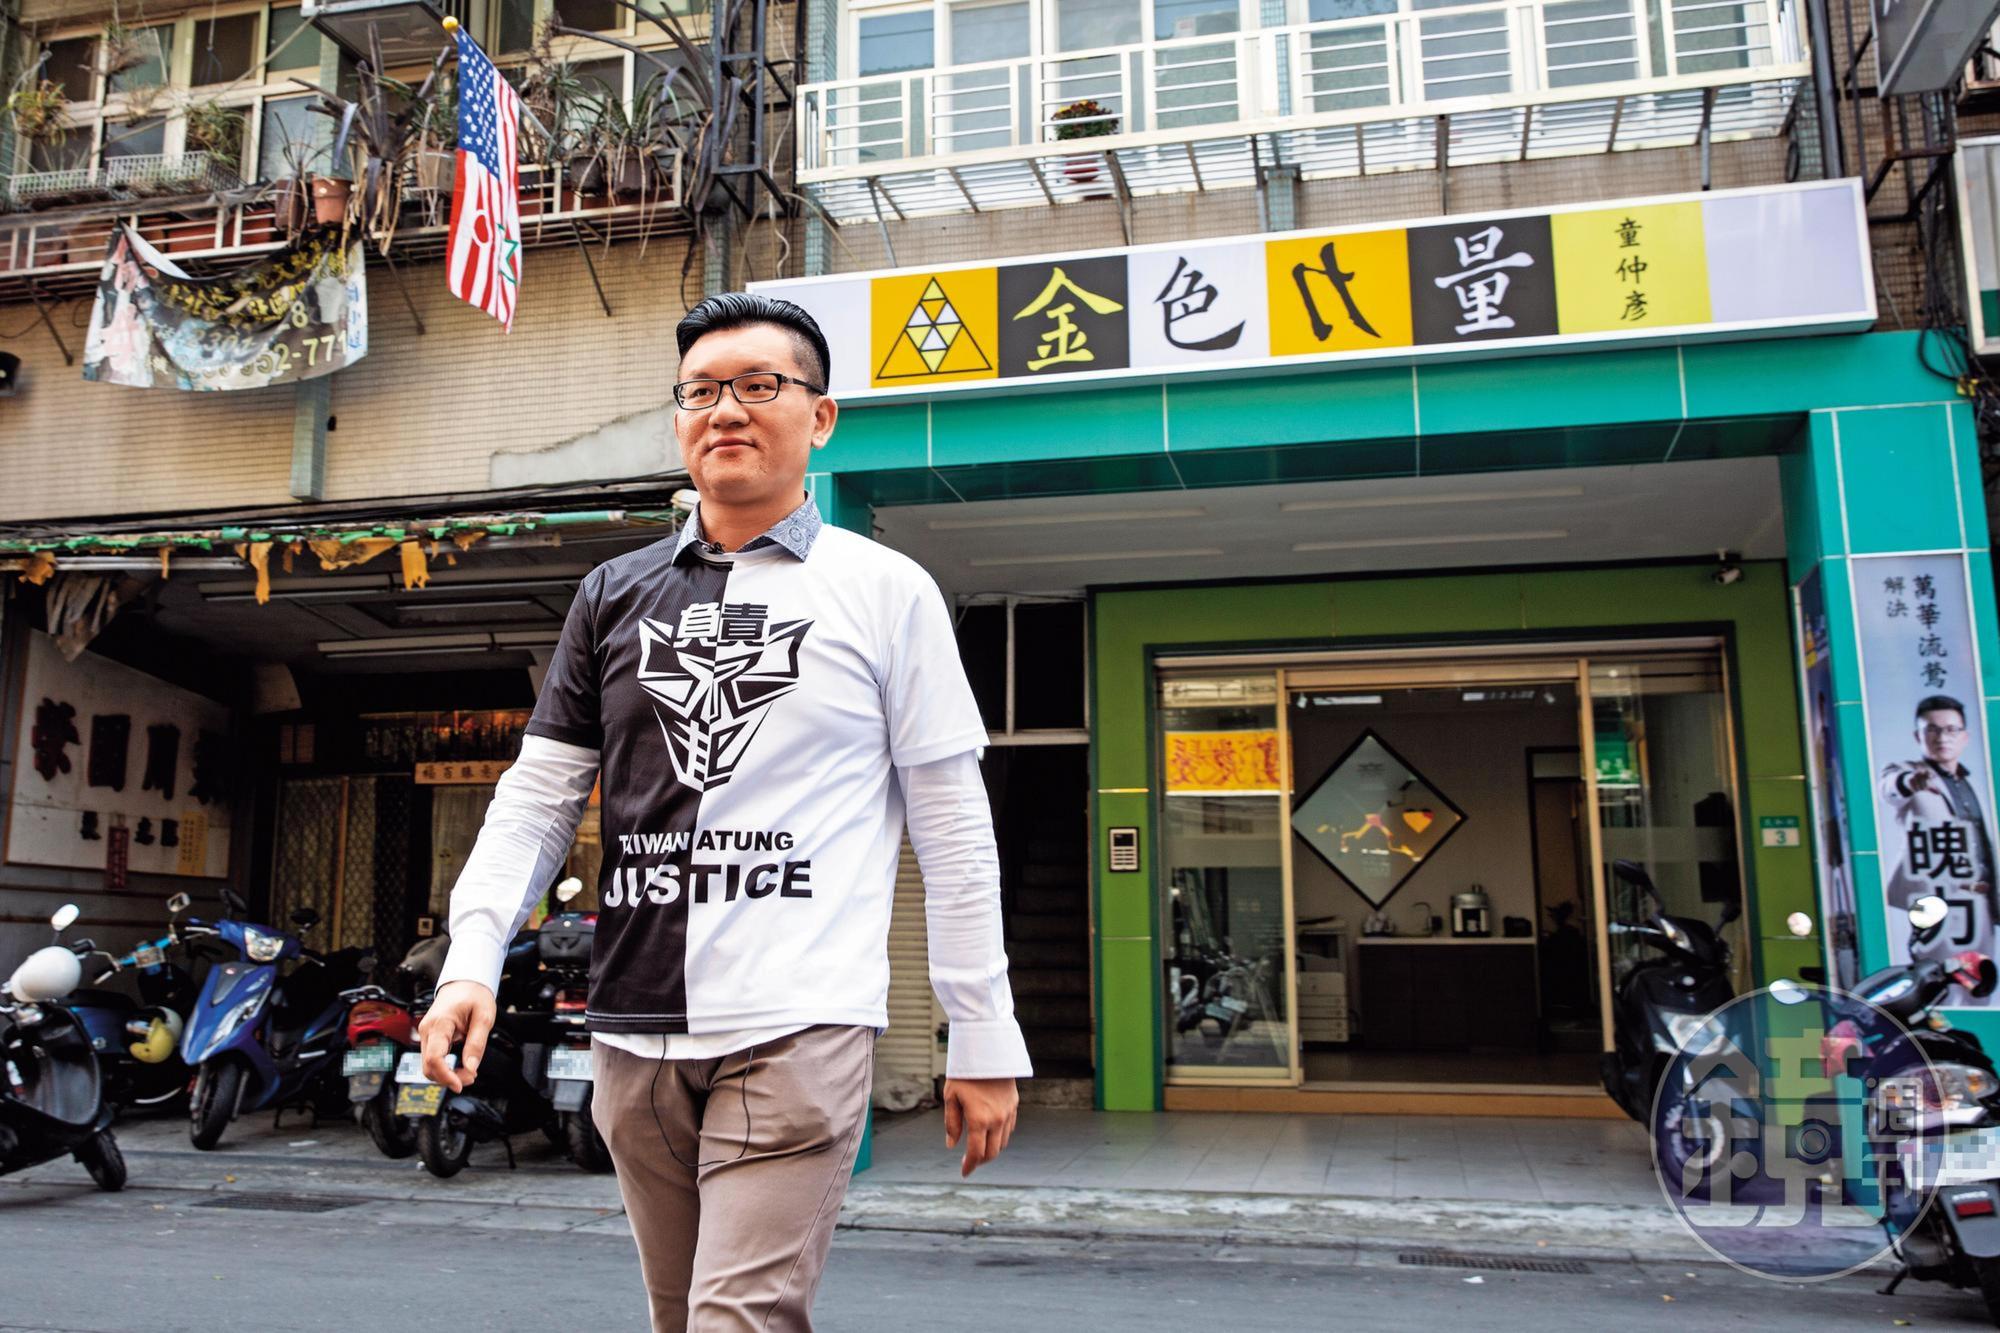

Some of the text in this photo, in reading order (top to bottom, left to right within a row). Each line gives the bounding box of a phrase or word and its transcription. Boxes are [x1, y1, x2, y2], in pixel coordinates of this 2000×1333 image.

[1883, 575, 1908, 618] 解決
[673, 602, 768, 649] 負責
[1912, 573, 1948, 689] 萬華流鶯
[619, 830, 794, 855] TAIWAN ATUNG
[1775, 830, 1787, 845] 3
[604, 860, 813, 908] JUSTICE
